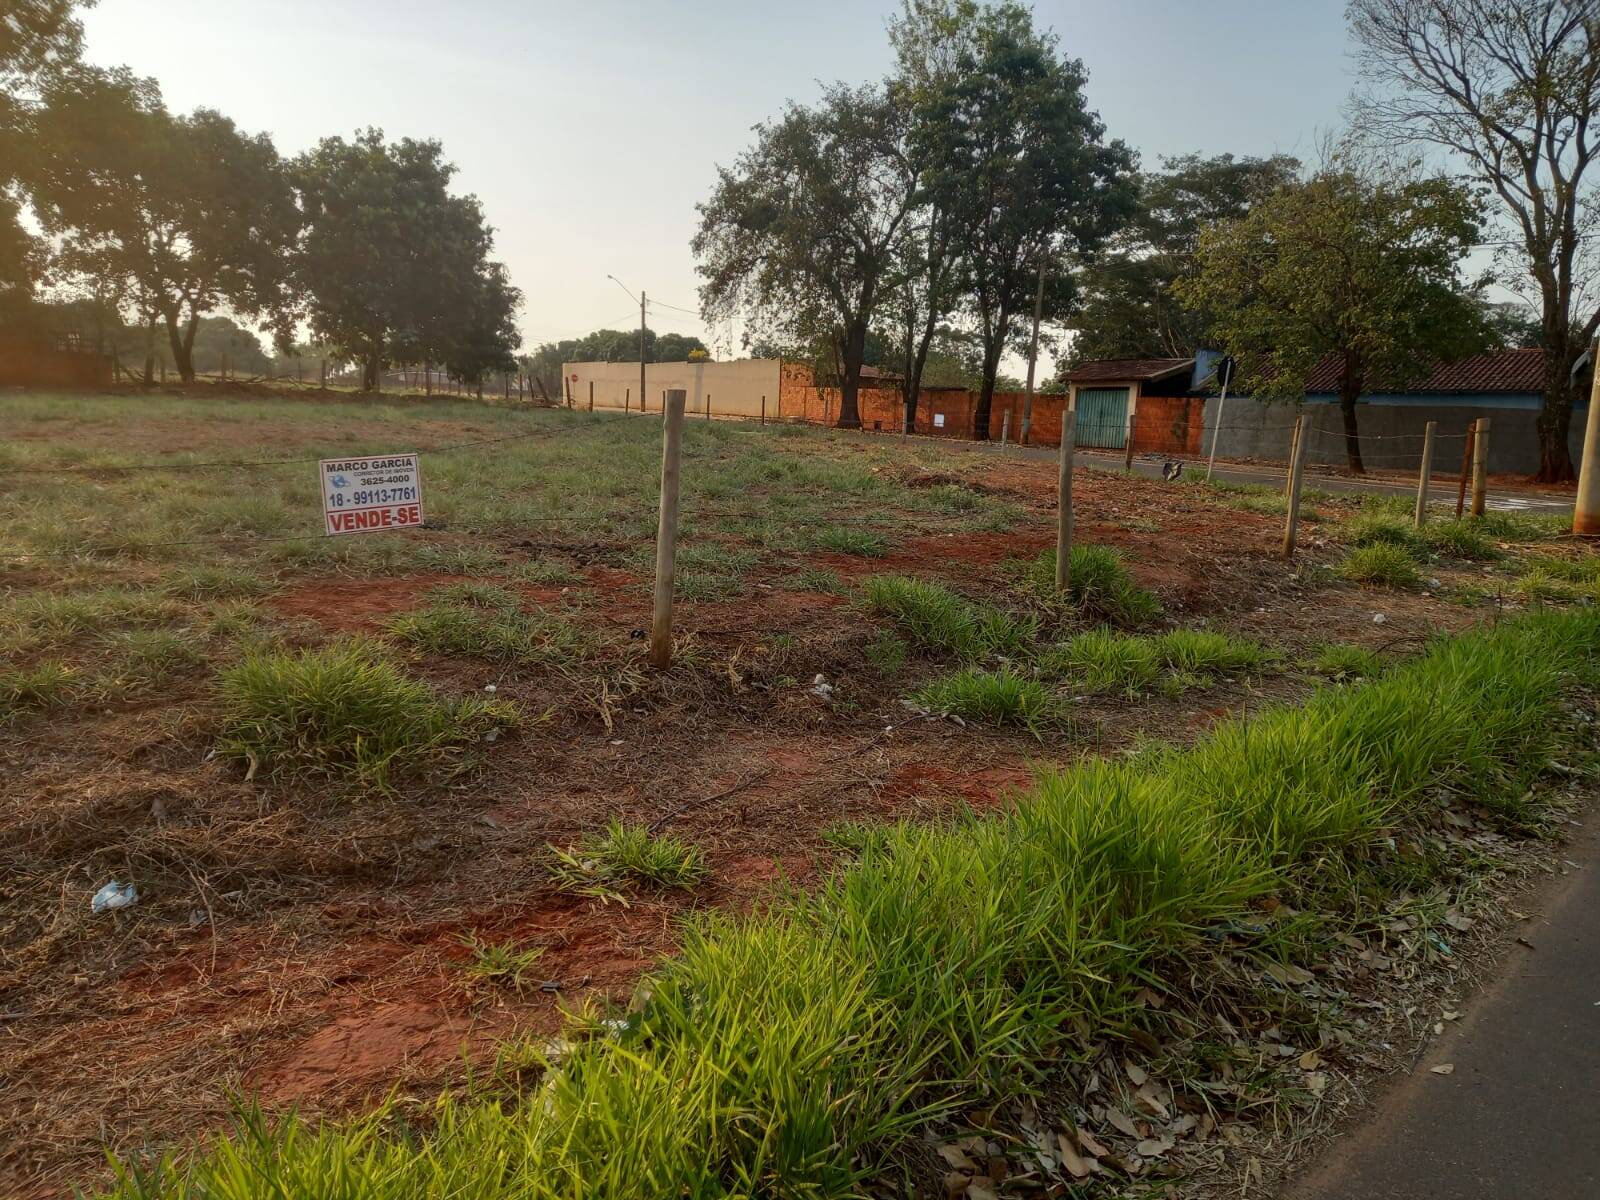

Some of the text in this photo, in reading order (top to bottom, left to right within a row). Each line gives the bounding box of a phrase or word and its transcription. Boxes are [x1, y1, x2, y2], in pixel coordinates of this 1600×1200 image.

[326, 458, 413, 472] MARCO GARCIA
[360, 475, 410, 486] 3625-4000
[329, 493, 344, 507] 18
[353, 486, 416, 505] 99113-7761
[329, 506, 420, 531] VENDE-SE
